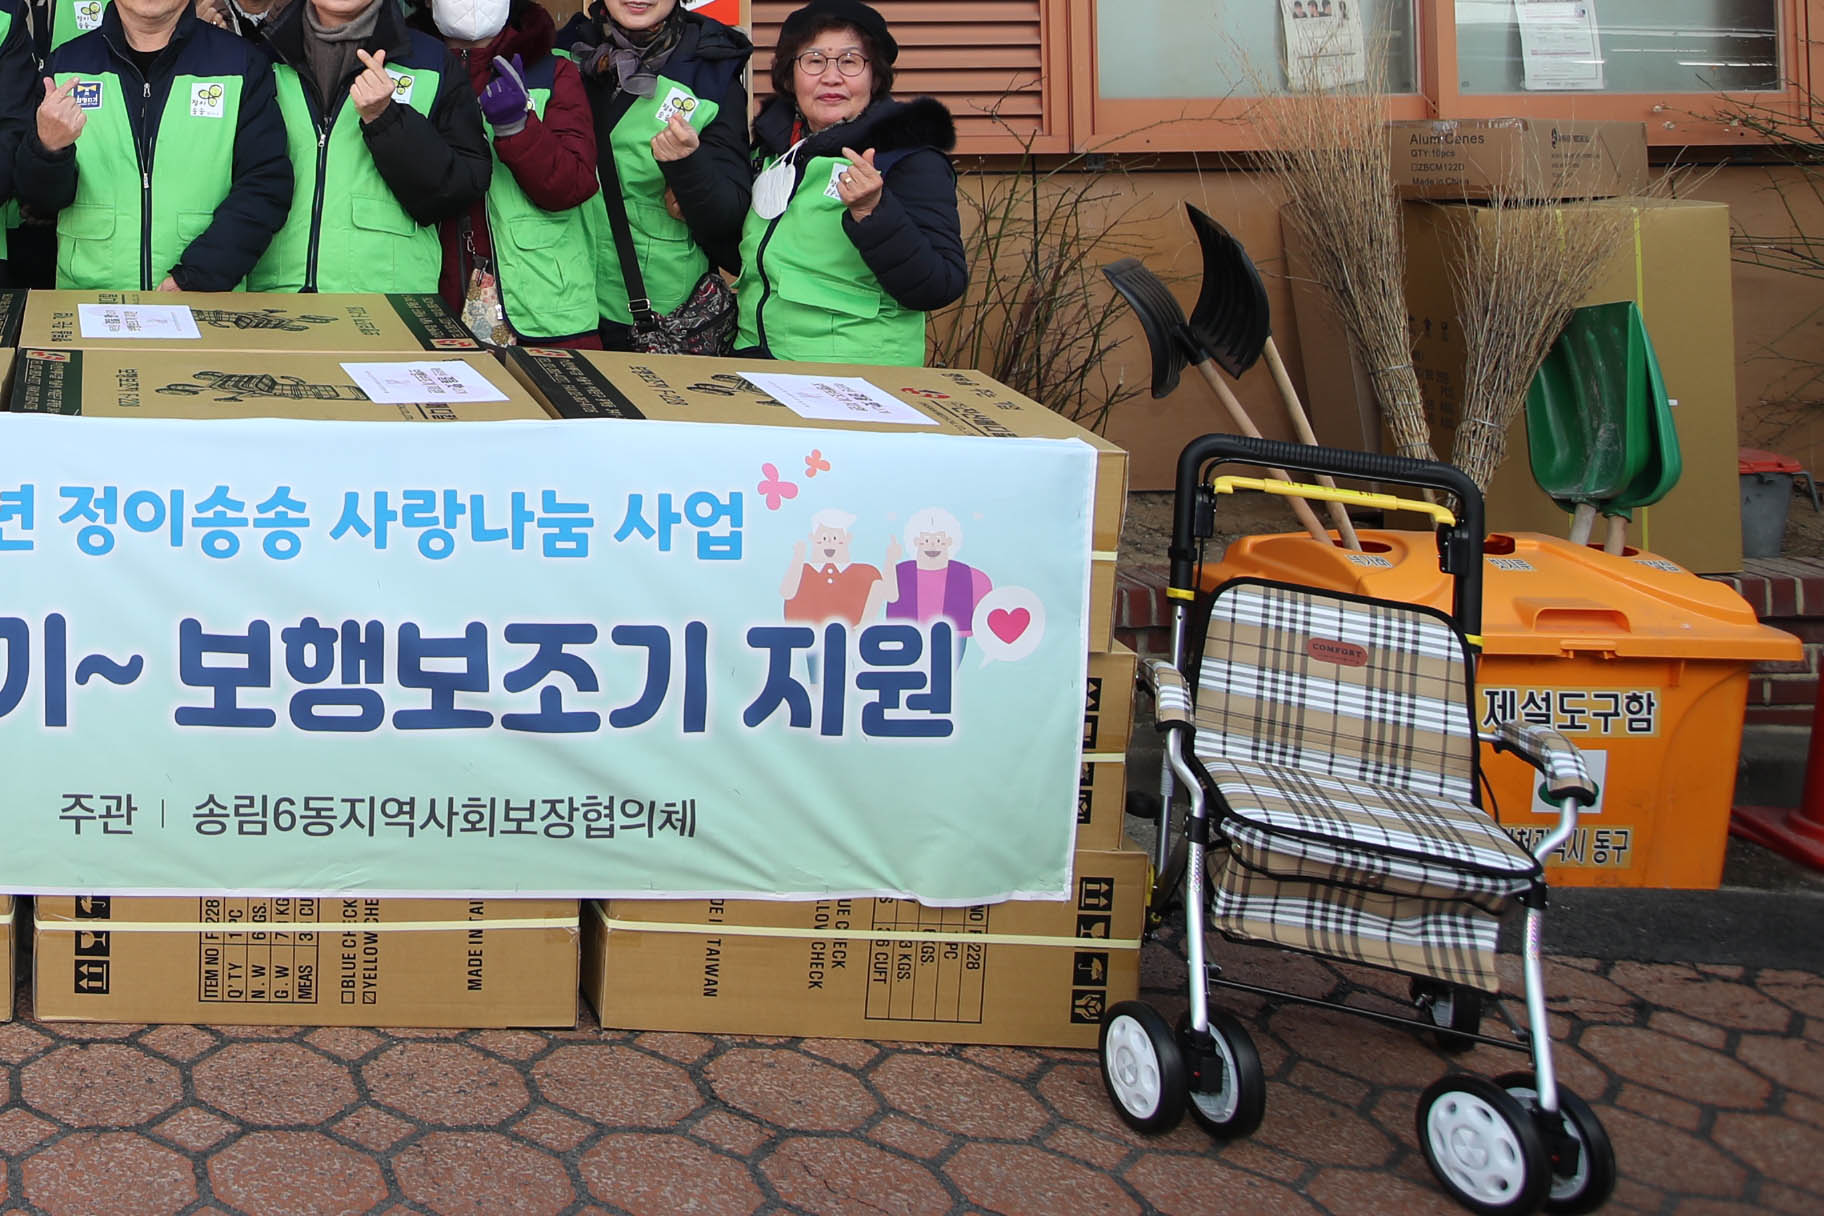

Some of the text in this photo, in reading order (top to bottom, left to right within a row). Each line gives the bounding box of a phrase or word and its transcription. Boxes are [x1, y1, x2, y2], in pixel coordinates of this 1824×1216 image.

[57, 484, 311, 560] 정이송송
[328, 488, 595, 561] 사랑나눔
[613, 491, 743, 561] 사업
[1312, 643, 1363, 659] COMFORT
[174, 615, 708, 734] 보행보조기
[742, 619, 955, 738] 지원
[1481, 688, 1658, 734] 제설도구함
[57, 792, 699, 839] 주관 송림6동지역사회보장협의체
[1593, 830, 1629, 864] 동구
[205, 948, 219, 965] NO
[362, 932, 378, 988] YELLOW
[467, 930, 483, 991] MADE IN
[808, 941, 826, 989] CHECK
[831, 921, 850, 968] CECK
[204, 969, 219, 998] ITEM
[298, 965, 313, 999] MEAS
[341, 953, 356, 988] BLUE
[703, 939, 721, 998] TAIWAN
[872, 952, 889, 984] CUFT
[896, 953, 912, 983] KGS.
